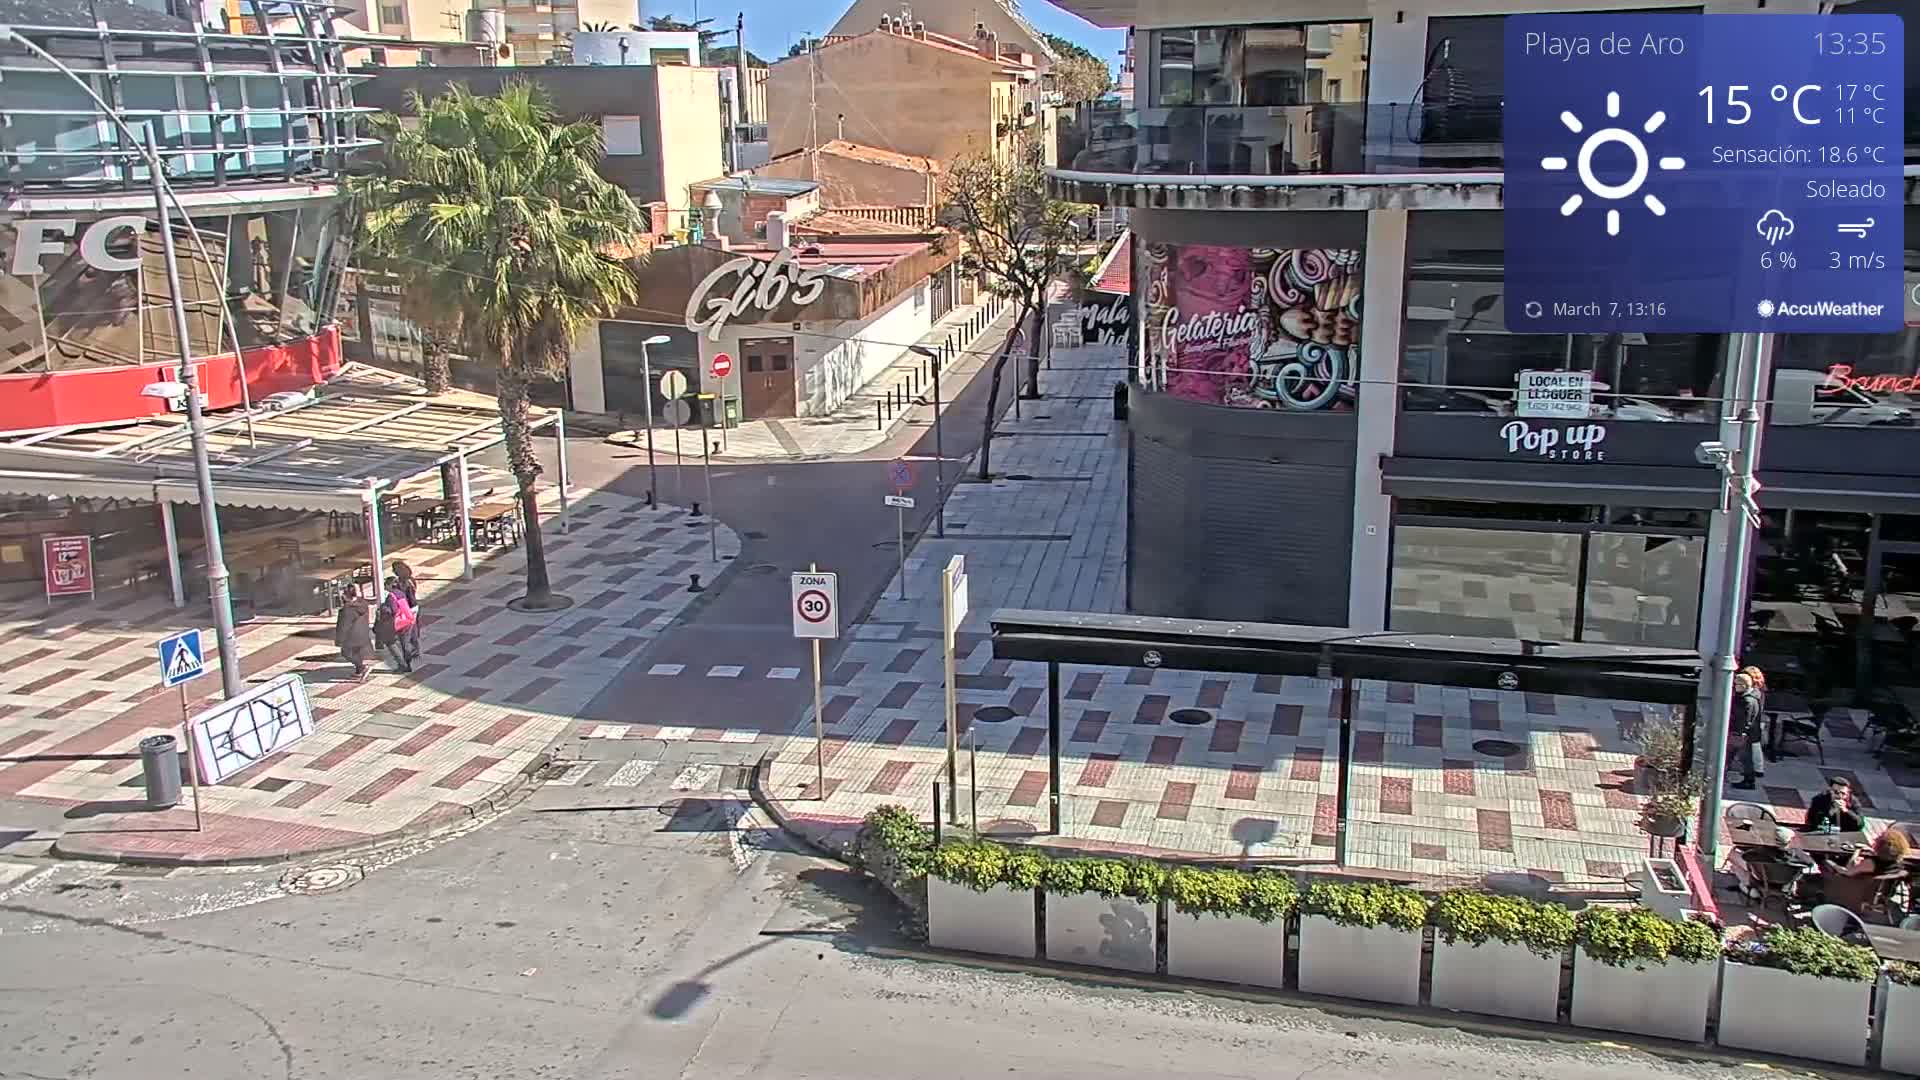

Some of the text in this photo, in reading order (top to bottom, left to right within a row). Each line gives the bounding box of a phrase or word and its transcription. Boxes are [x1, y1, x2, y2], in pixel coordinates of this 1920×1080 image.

[0, 215, 147, 275] FC
[686, 247, 825, 342] Gib's
[1162, 305, 1259, 353] Gelateria
[1529, 376, 1584, 387] LOCAL EN
[1528, 389, 1582, 400] LLOGUER
[1500, 420, 1606, 455] Pop up
[1548, 449, 1606, 461] STORE
[800, 576, 826, 585] ZONA
[804, 600, 824, 612] 30
